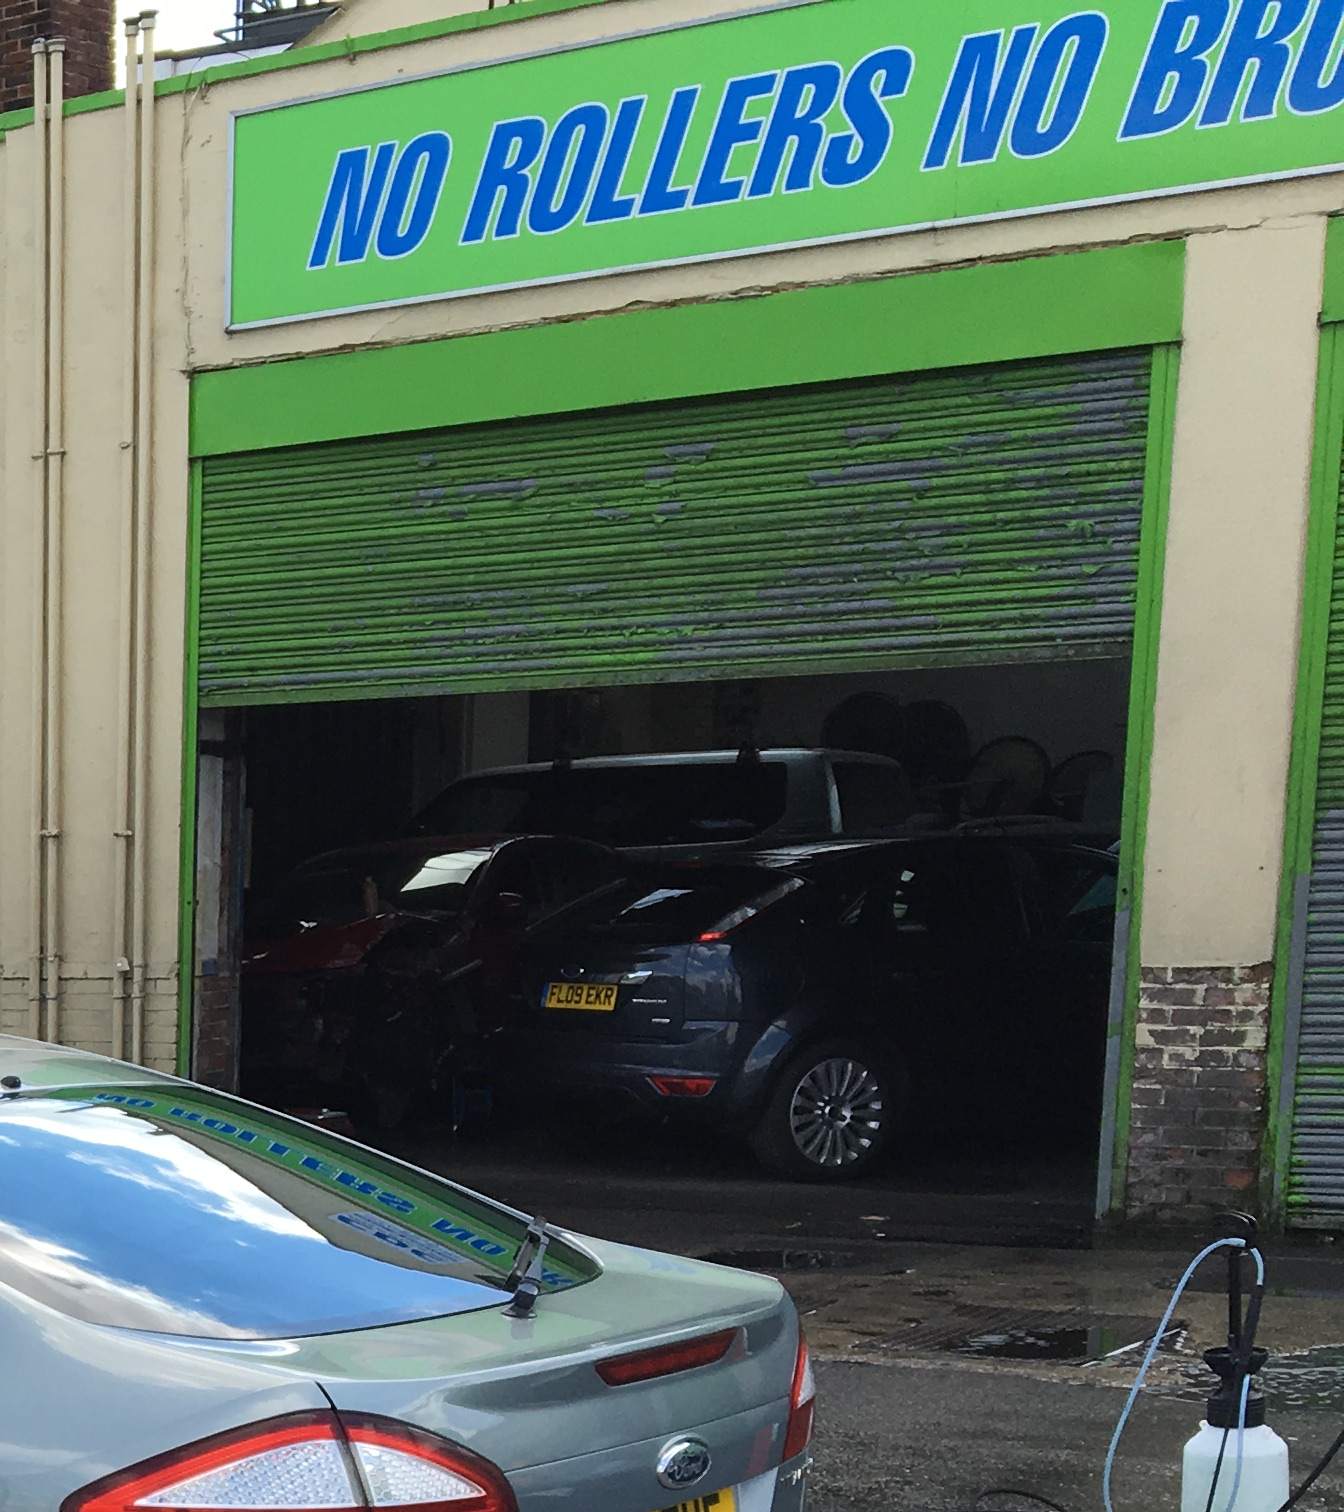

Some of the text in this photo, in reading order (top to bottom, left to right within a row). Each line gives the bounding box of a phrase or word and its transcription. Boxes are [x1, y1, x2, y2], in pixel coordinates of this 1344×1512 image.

[306, 130, 452, 271] NO
[458, 45, 915, 247] ROLLERS
[921, 9, 1111, 172] NO
[549, 985, 615, 1005] FL09 EKR
